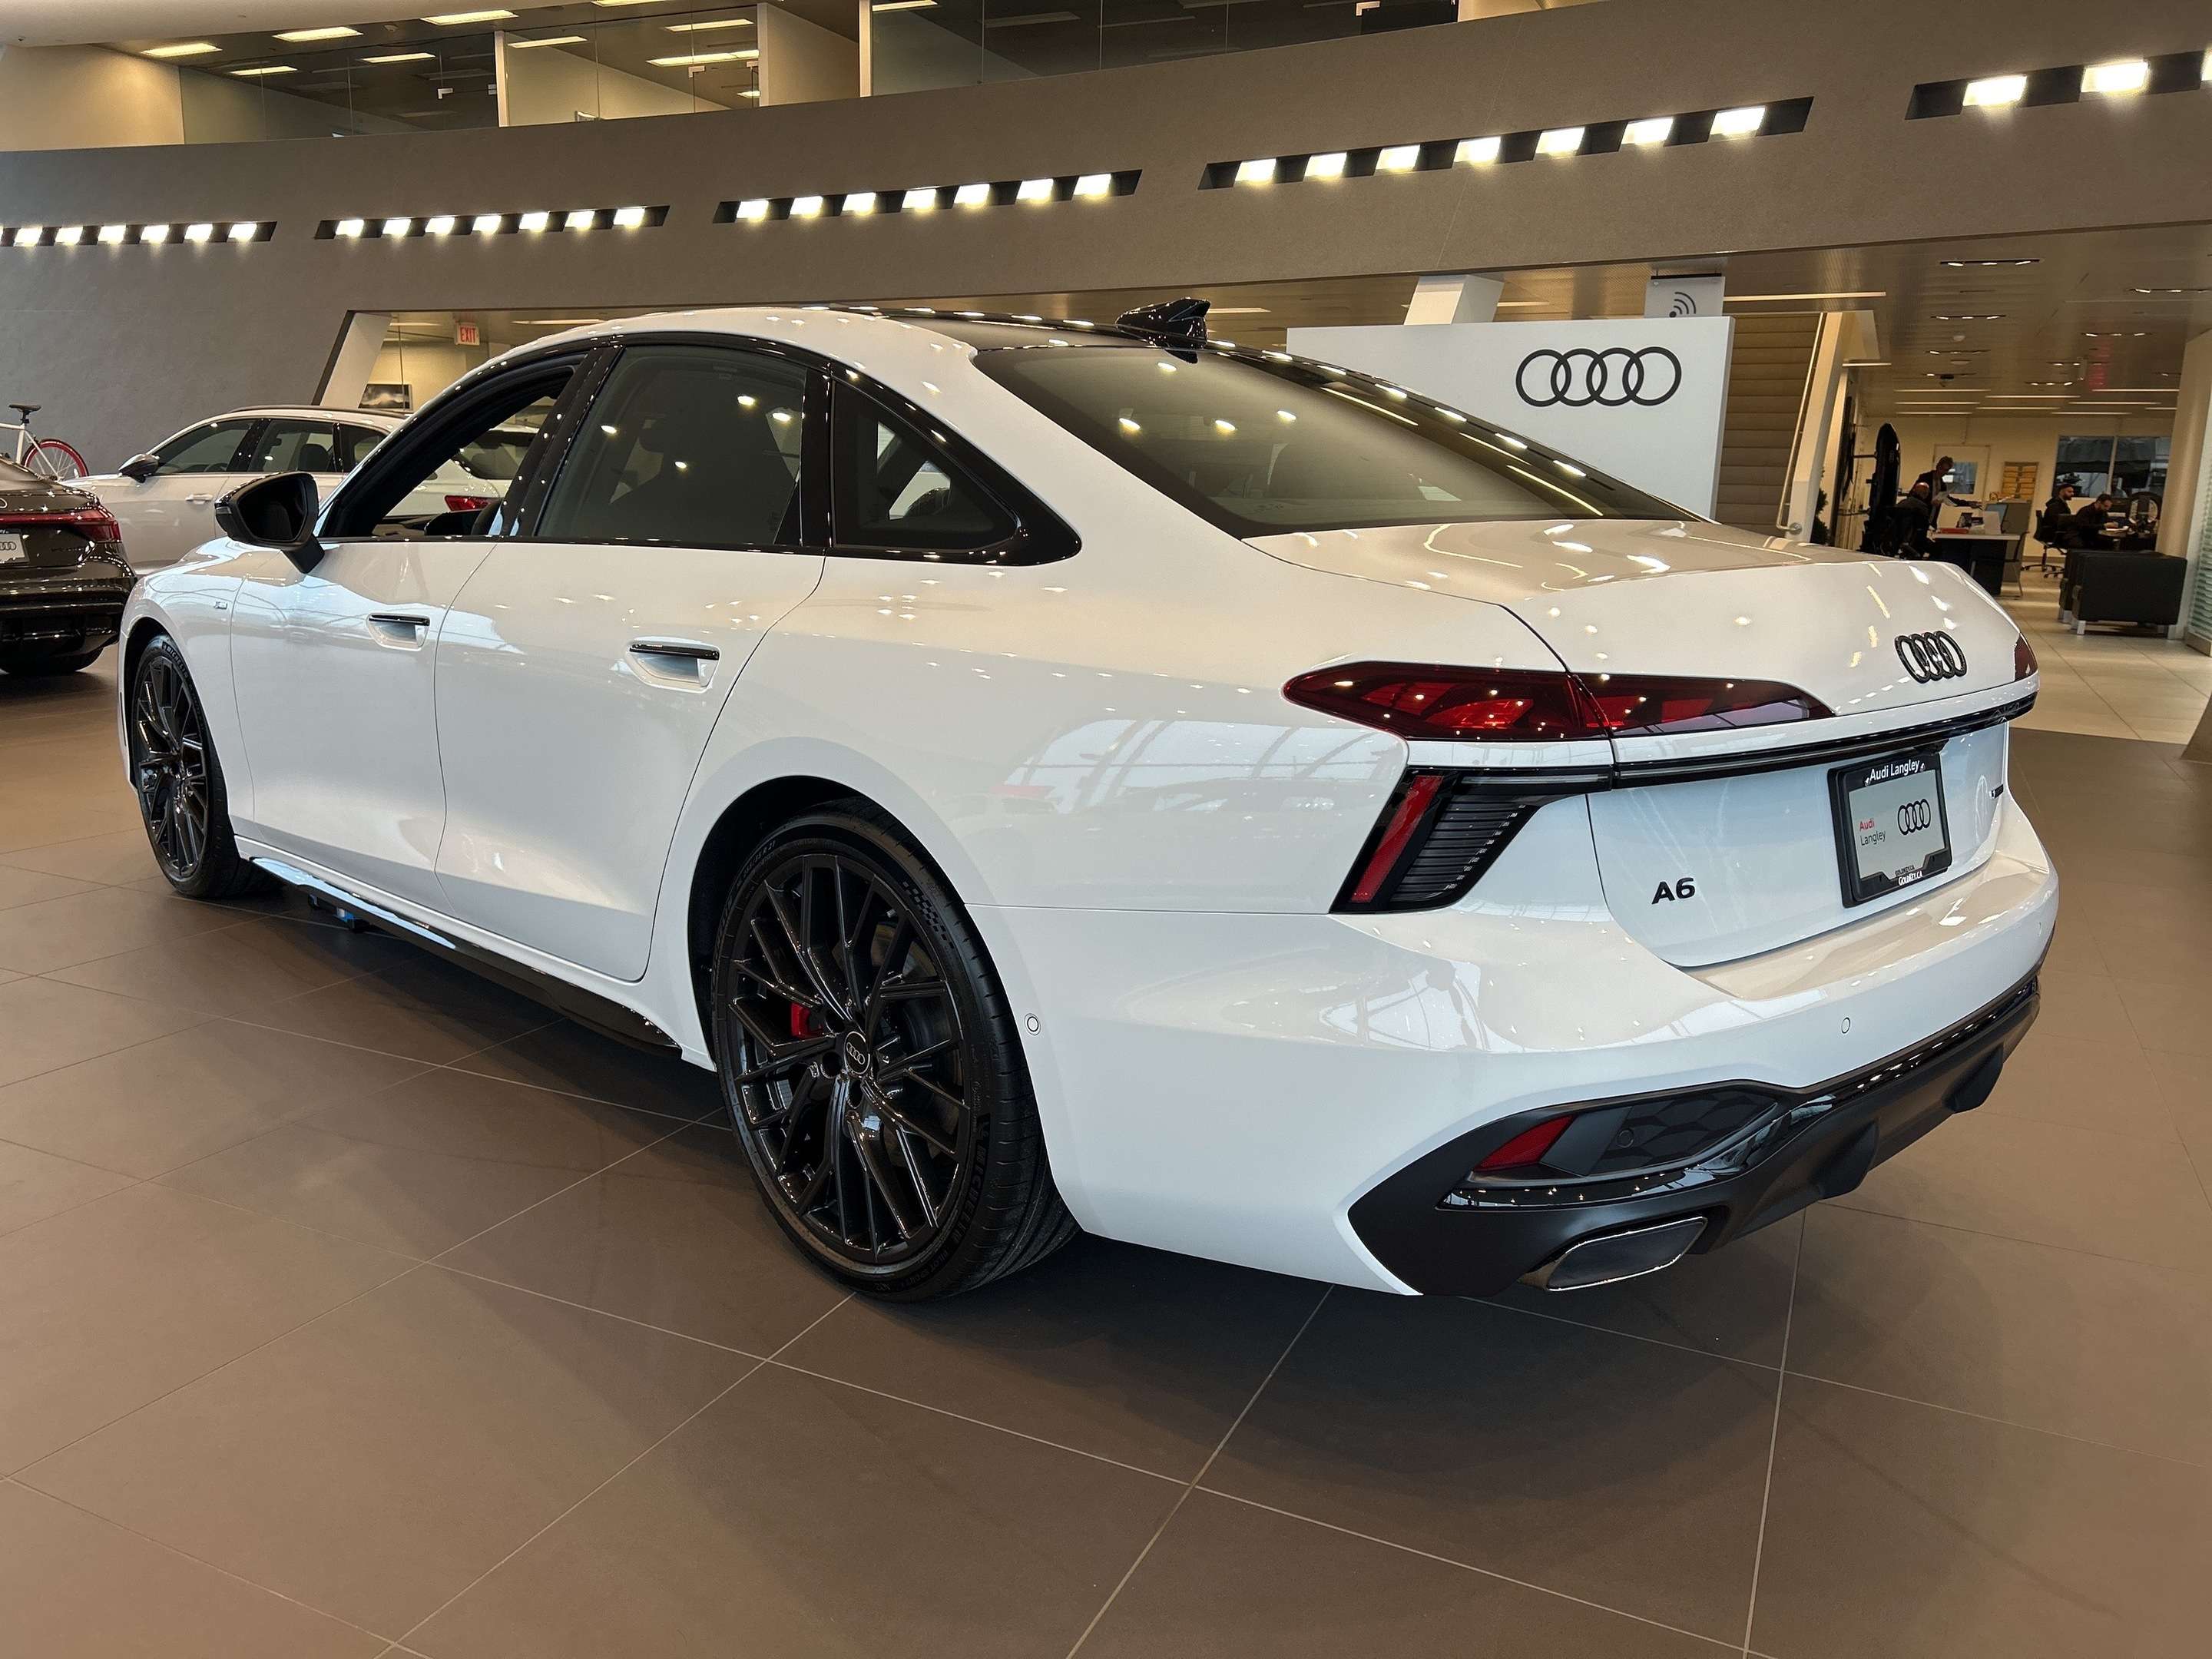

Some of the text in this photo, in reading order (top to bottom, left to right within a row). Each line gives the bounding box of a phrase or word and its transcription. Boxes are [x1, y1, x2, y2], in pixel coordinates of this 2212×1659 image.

[460, 327, 476, 343] EXIT
[167, 645, 189, 677] MICHELIN
[1869, 759, 1920, 781] Audi Langley
[1859, 818, 1886, 846] Audi Langley
[1651, 877, 1696, 905] A6
[952, 1144, 985, 1243] MICHELIN
